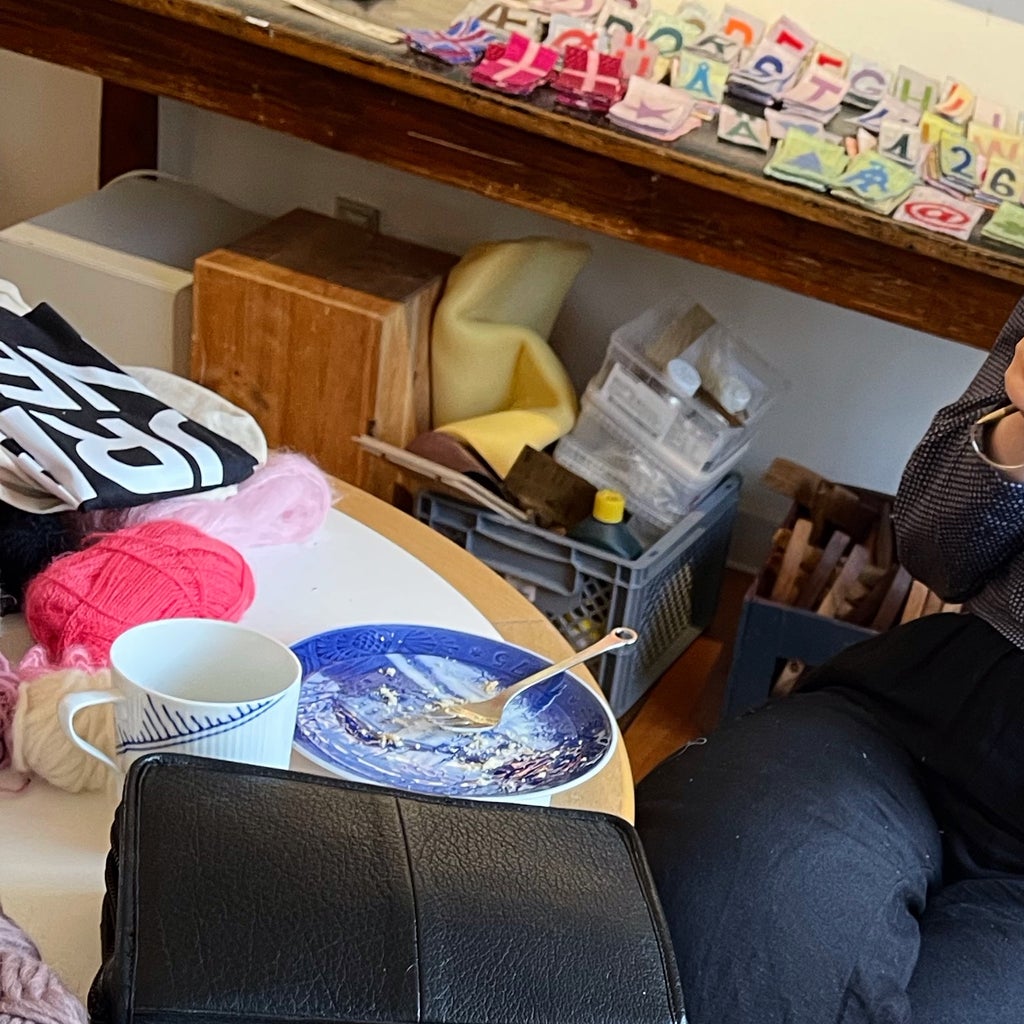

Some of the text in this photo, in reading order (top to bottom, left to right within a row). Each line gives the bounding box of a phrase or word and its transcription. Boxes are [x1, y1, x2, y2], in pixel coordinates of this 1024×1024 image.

[950, 146, 974, 178] 2
[989, 167, 1016, 197] 6
[904, 201, 972, 232] @
